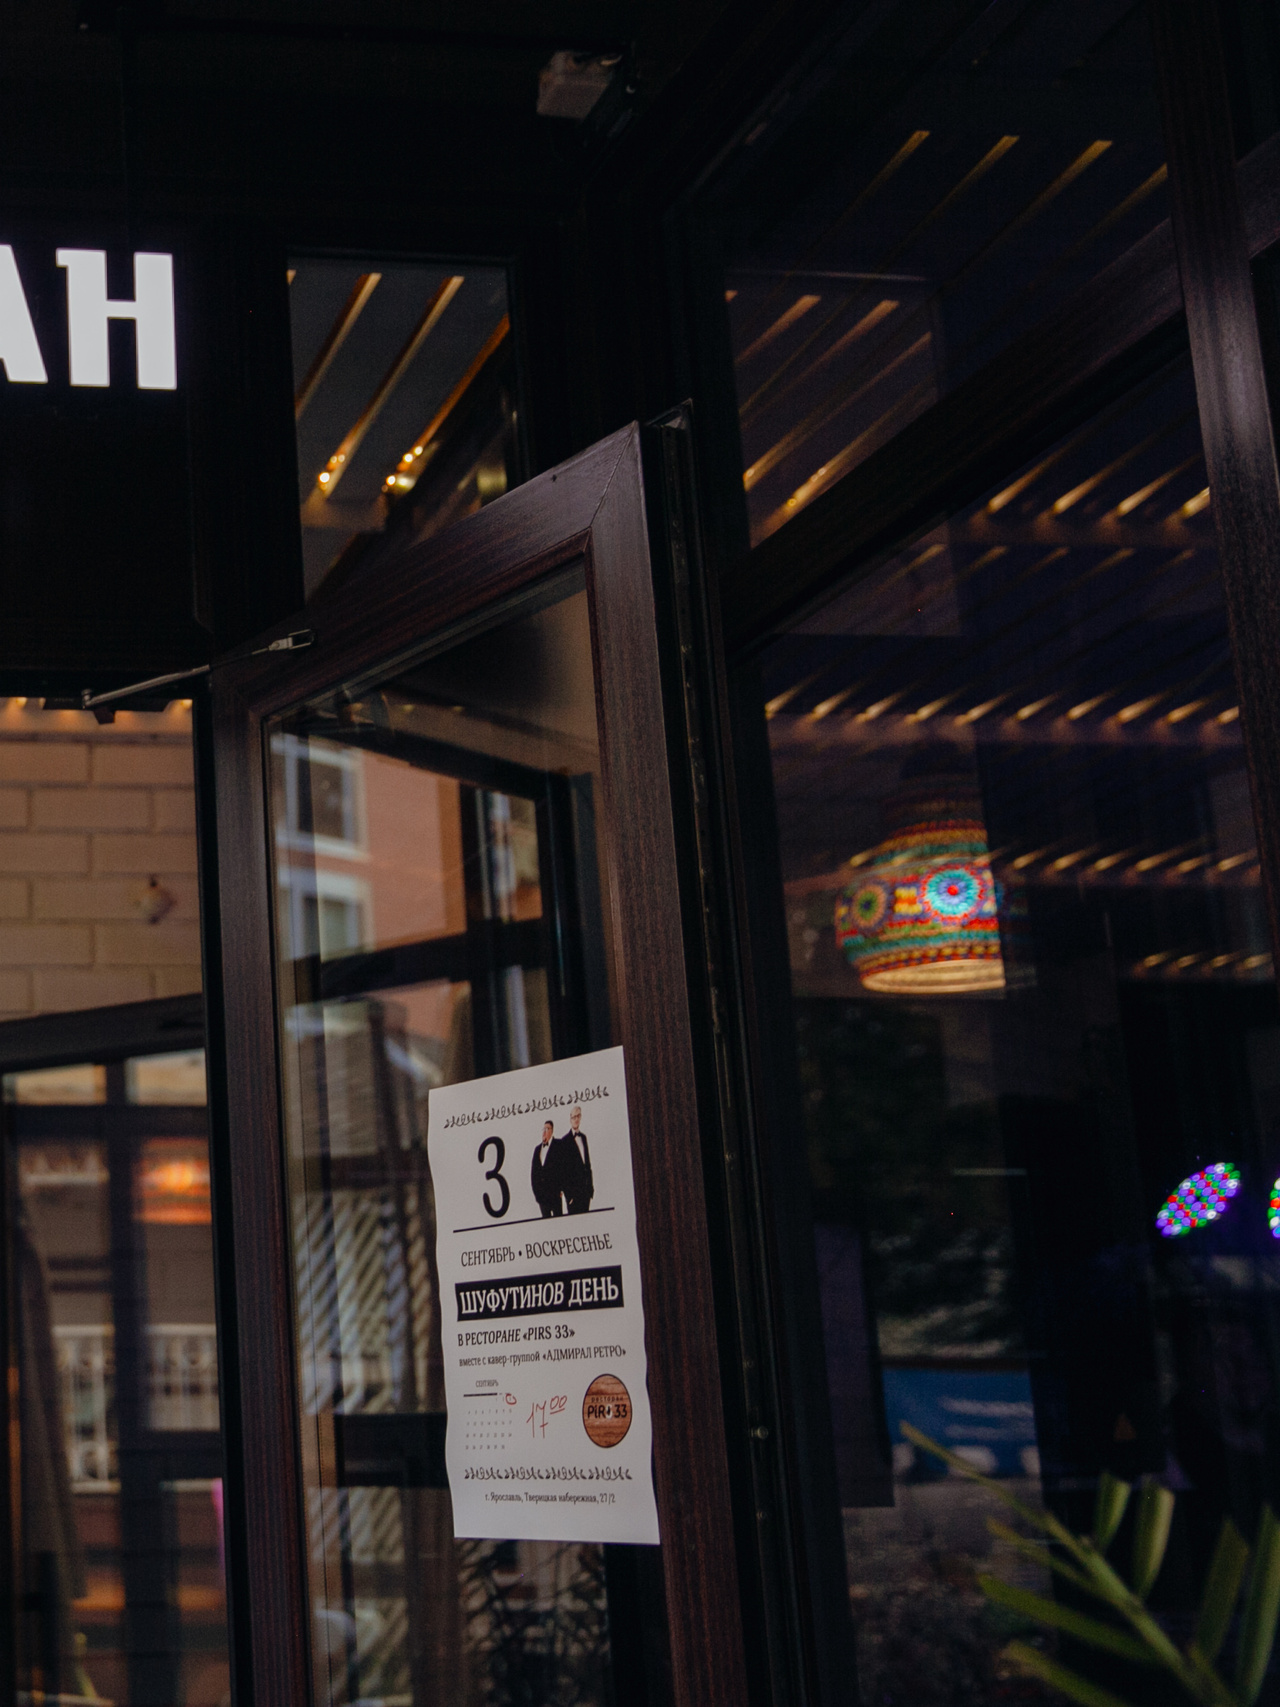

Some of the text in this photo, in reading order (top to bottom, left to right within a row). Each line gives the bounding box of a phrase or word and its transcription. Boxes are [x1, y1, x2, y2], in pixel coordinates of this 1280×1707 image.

[477, 1136, 510, 1218] 3
[461, 1233, 613, 1267] СЕНТЯБРЬ ВОСКРЕСЕНЬЕ
[459, 1276, 620, 1315] ШУФУТИНОВ ДЕНЬ
[457, 1324, 576, 1347] В РЕСТОРАНЕ «PIRS 33»
[459, 1344, 627, 1368] вместе с кавер-группой «АДМИРАЛ РЕТРО»
[614, 1404, 628, 1418] 33
